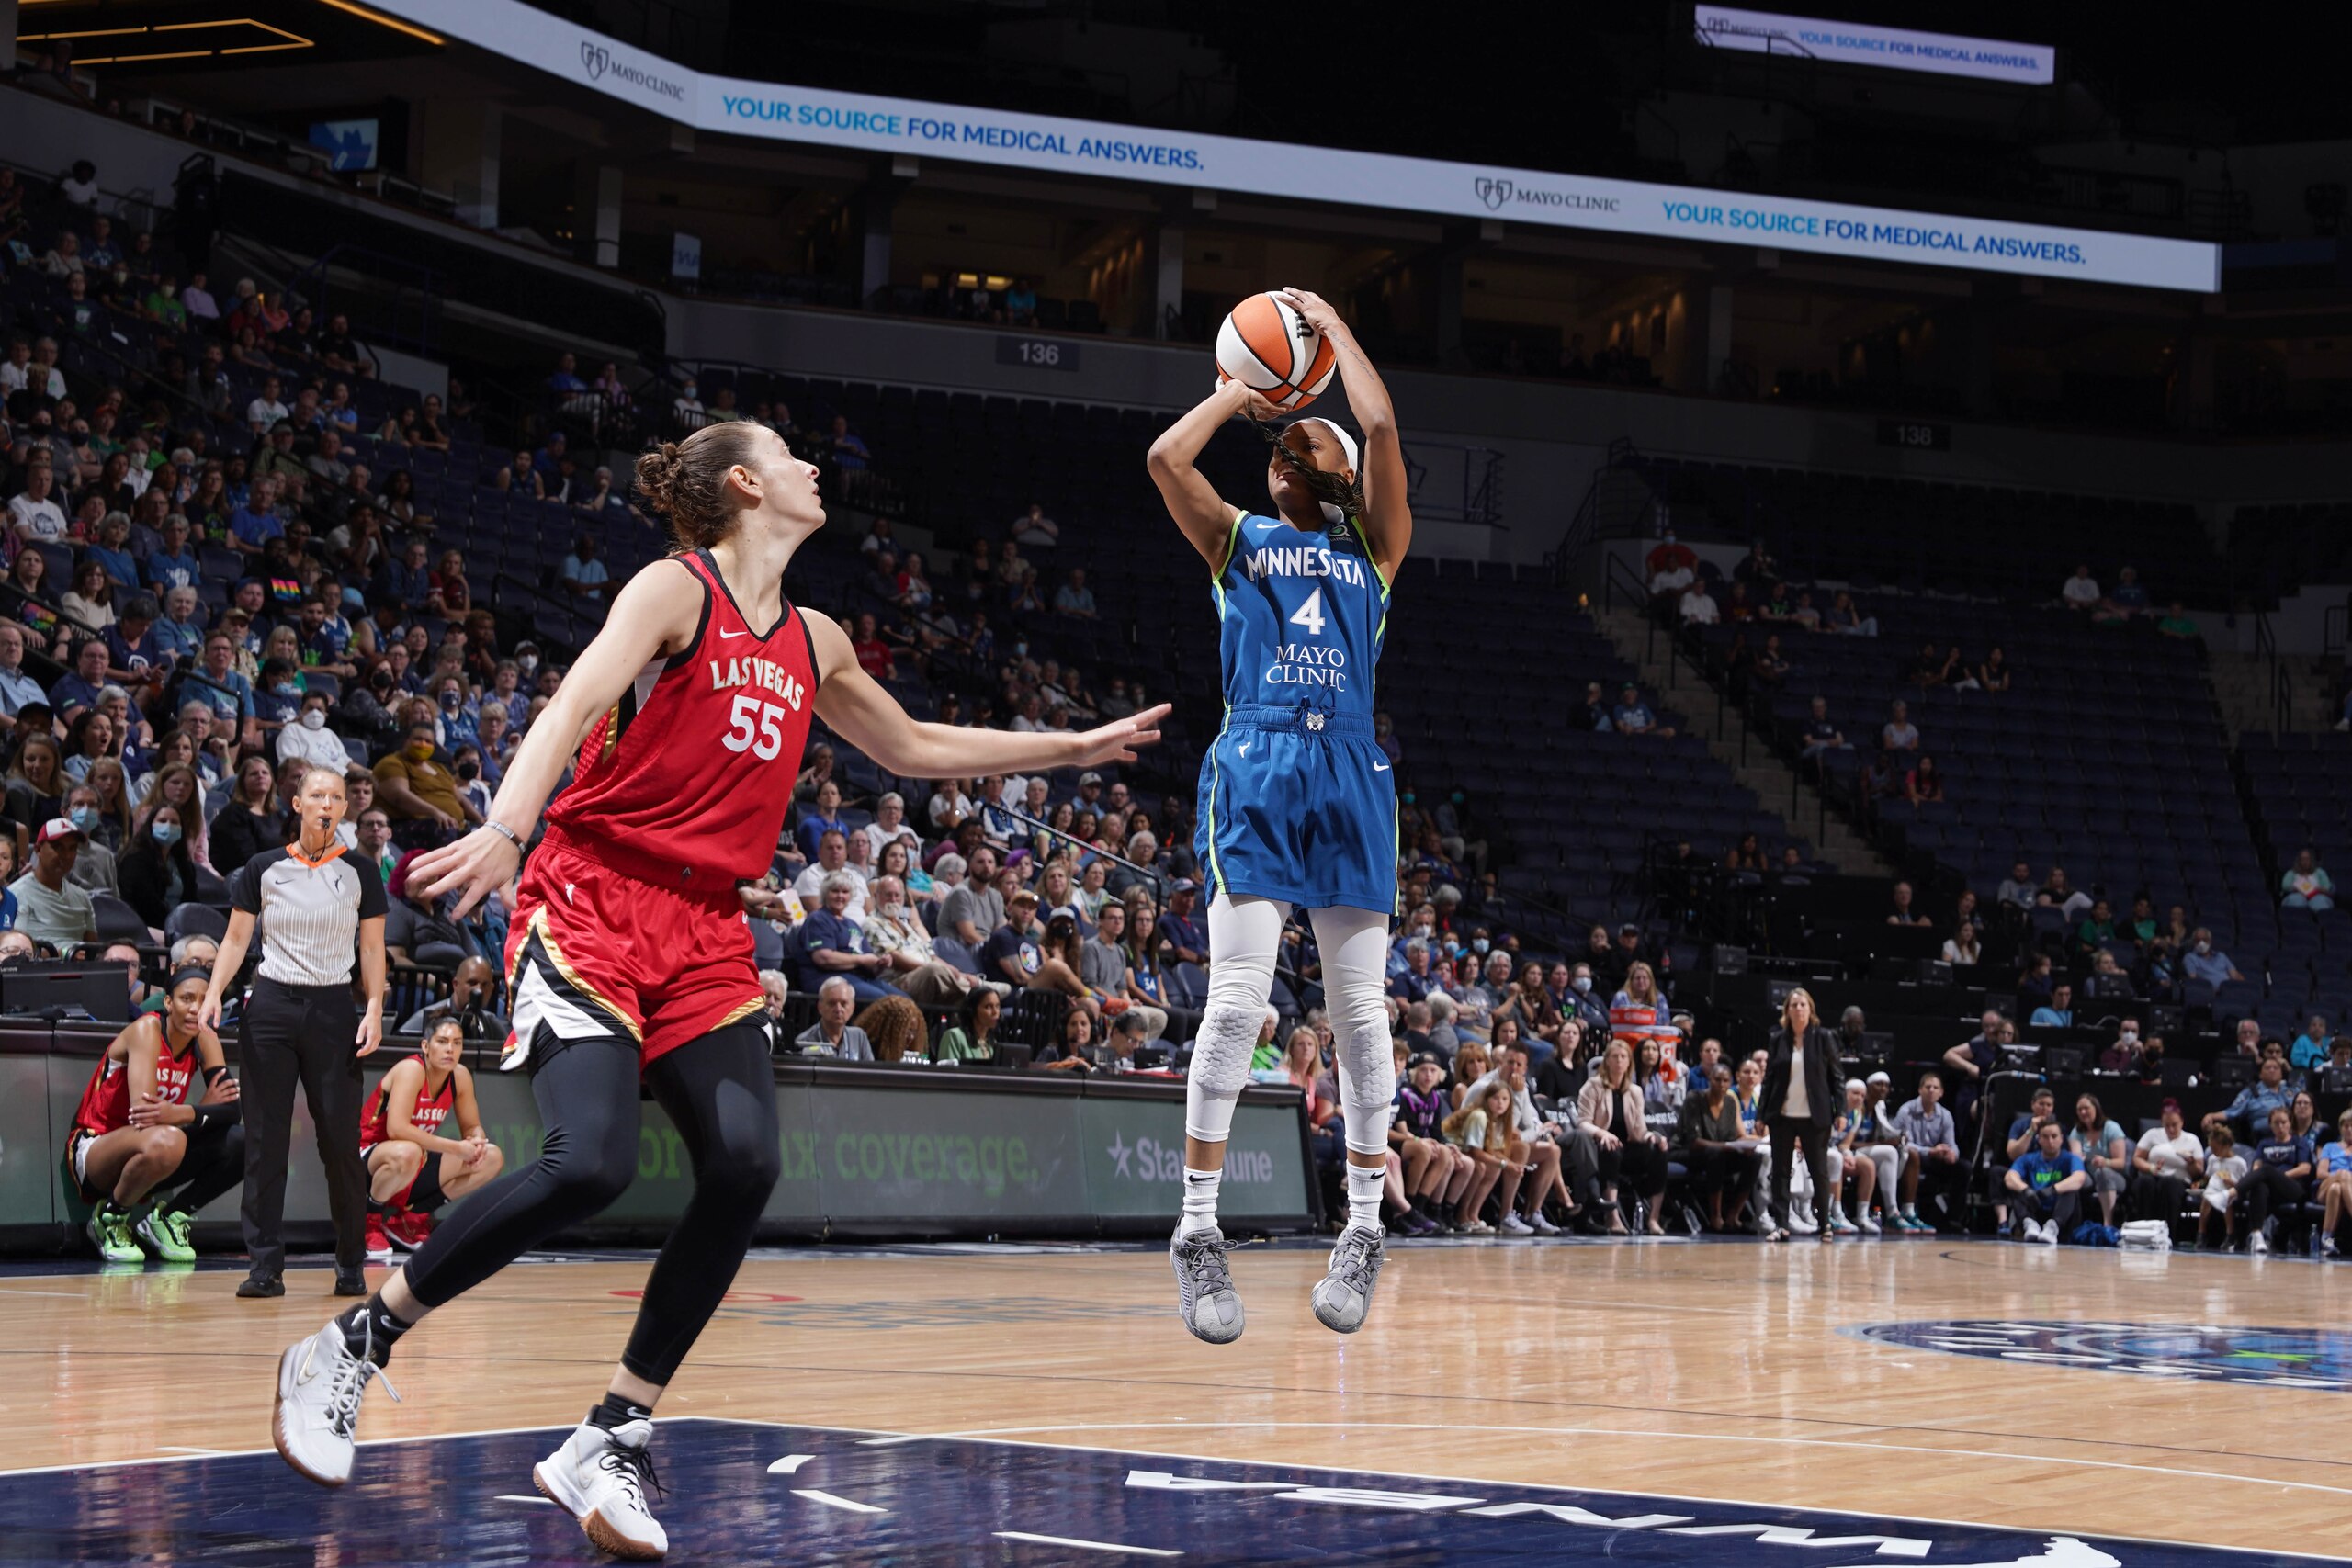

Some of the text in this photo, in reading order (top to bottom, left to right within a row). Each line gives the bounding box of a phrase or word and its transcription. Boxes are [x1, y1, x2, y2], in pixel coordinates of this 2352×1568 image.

[1799, 30, 2040, 71] YOUR SOURCE FOR MEDICAL ANSWERS.
[611, 61, 684, 101] MAYO CLINIC
[723, 95, 1204, 171] YOUR SOURCE FOR MEDICAL ANSWERS.
[1516, 188, 1620, 212] MAYO CLINIC
[1662, 201, 2086, 265] YOUR SOURCE FOR MEDICAL ANSWERS.
[1019, 342, 1059, 365] 136
[1896, 425, 1933, 446] 138
[1245, 547, 1366, 589] MINNESOTA
[1290, 586, 1326, 636] 4
[1275, 643, 1345, 668] MAYO
[709, 656, 805, 712] LAS VEGAS
[1266, 664, 1347, 692] CLINIC
[721, 694, 786, 761] 55
[834, 1131, 1041, 1200] coverage.
[1125, 1470, 1932, 1558] WNBA
